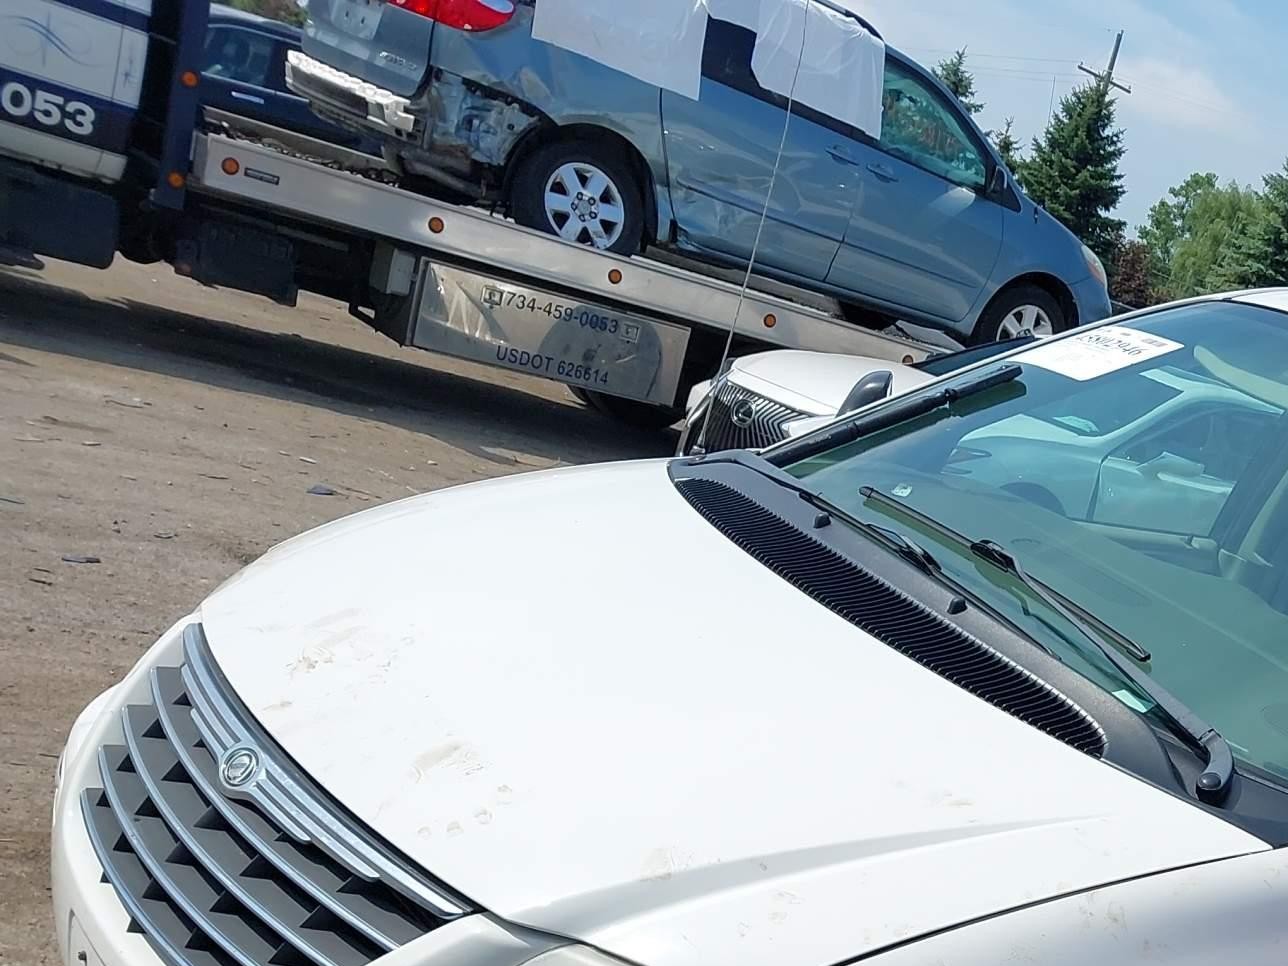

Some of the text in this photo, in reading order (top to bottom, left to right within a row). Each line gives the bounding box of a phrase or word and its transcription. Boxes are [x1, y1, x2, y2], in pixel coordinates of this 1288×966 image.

[2, 82, 96, 136] 053
[505, 291, 619, 334] 734-459-0053
[496, 345, 609, 385] USDOT 626614
